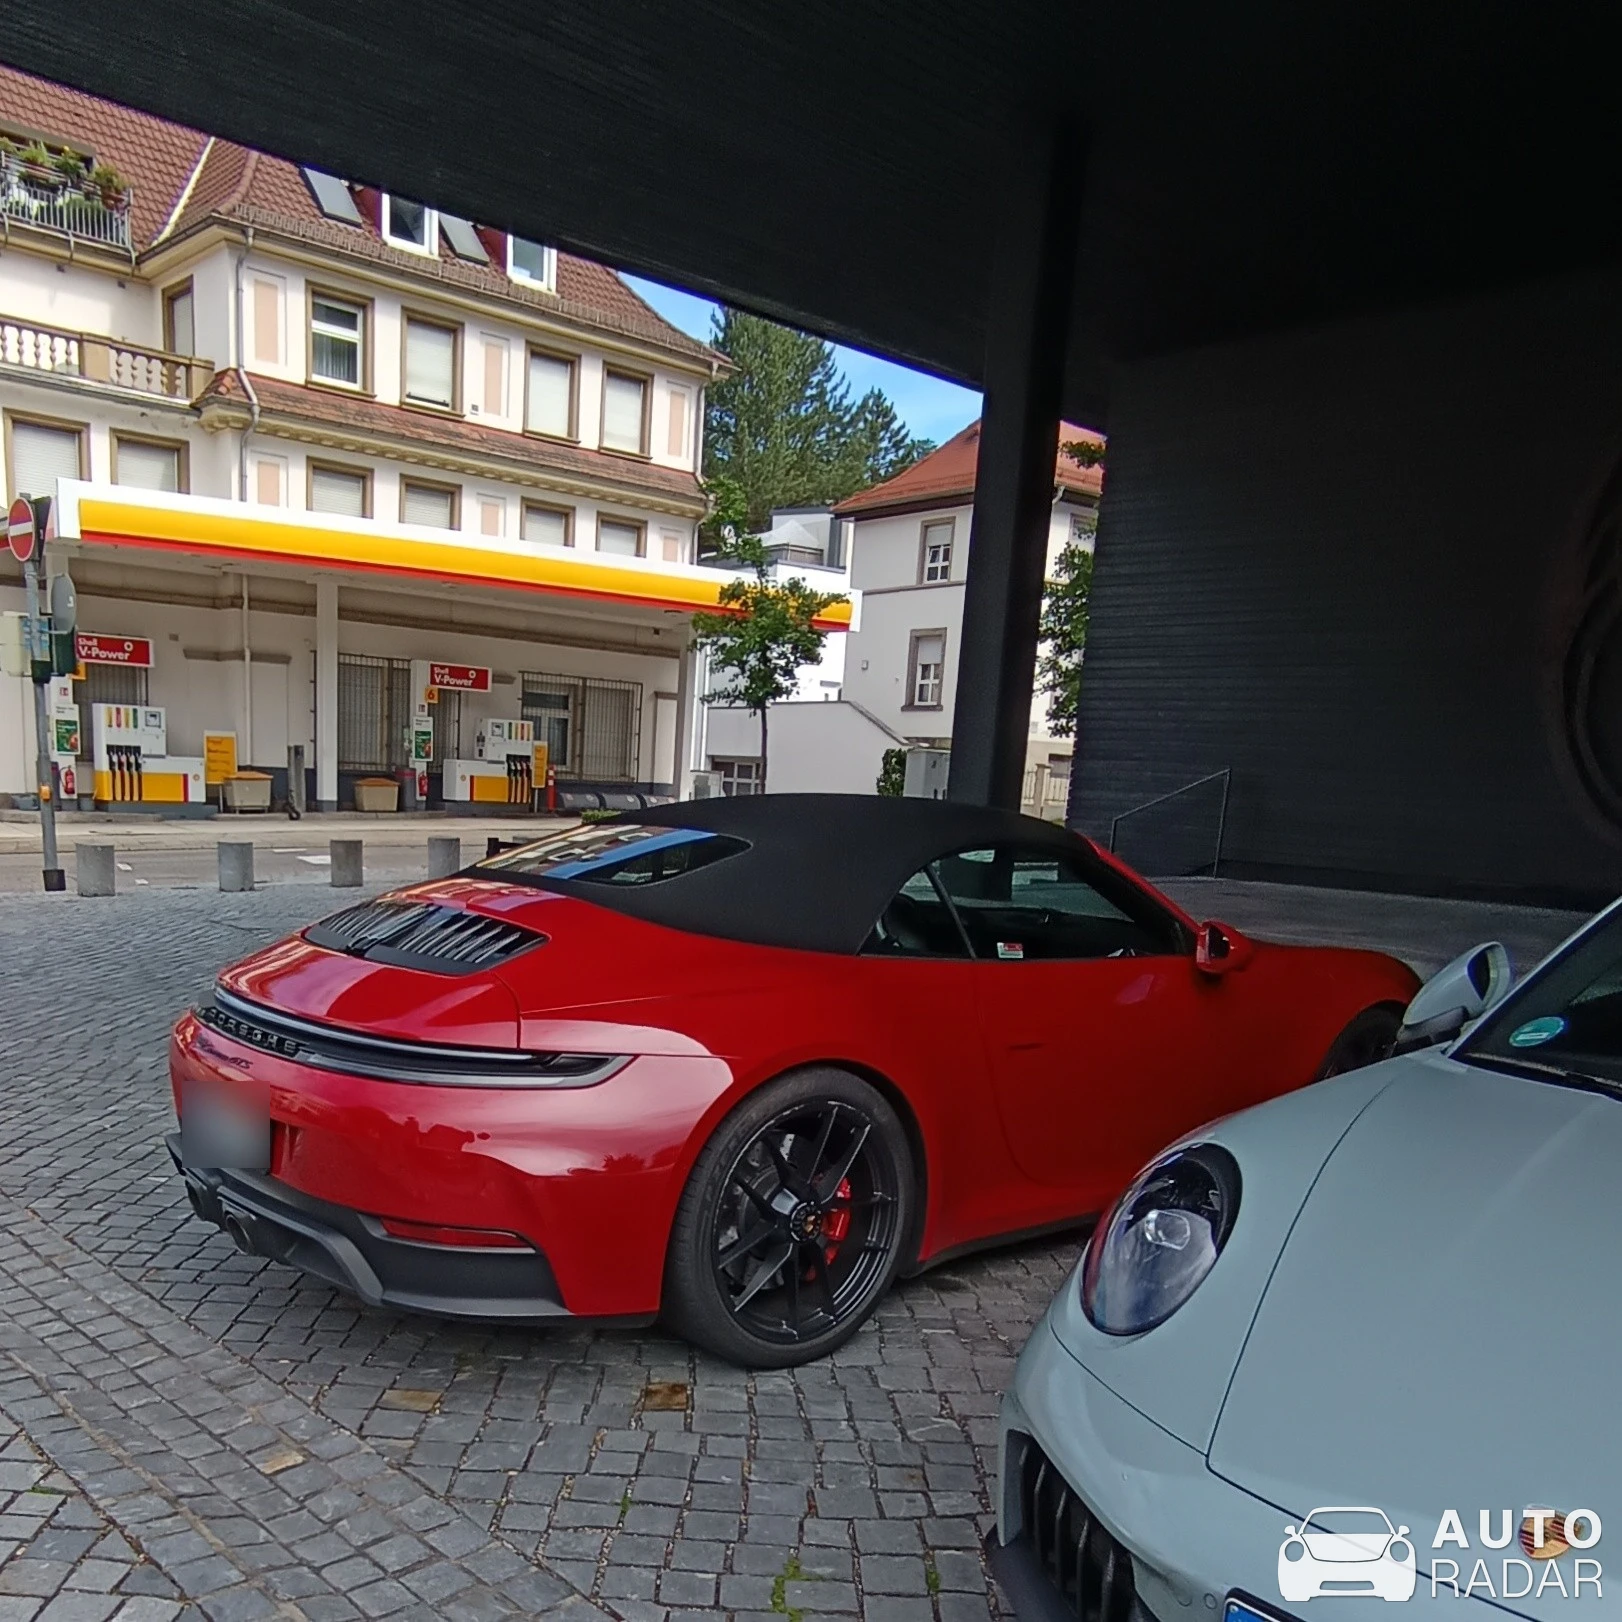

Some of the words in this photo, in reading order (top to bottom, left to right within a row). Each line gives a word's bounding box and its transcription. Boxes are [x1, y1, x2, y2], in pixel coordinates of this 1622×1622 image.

[79, 646, 130, 660] V-Power
[434, 674, 473, 686] V-Power
[428, 690, 436, 700] 6
[207, 1008, 297, 1053] PORSCHE
